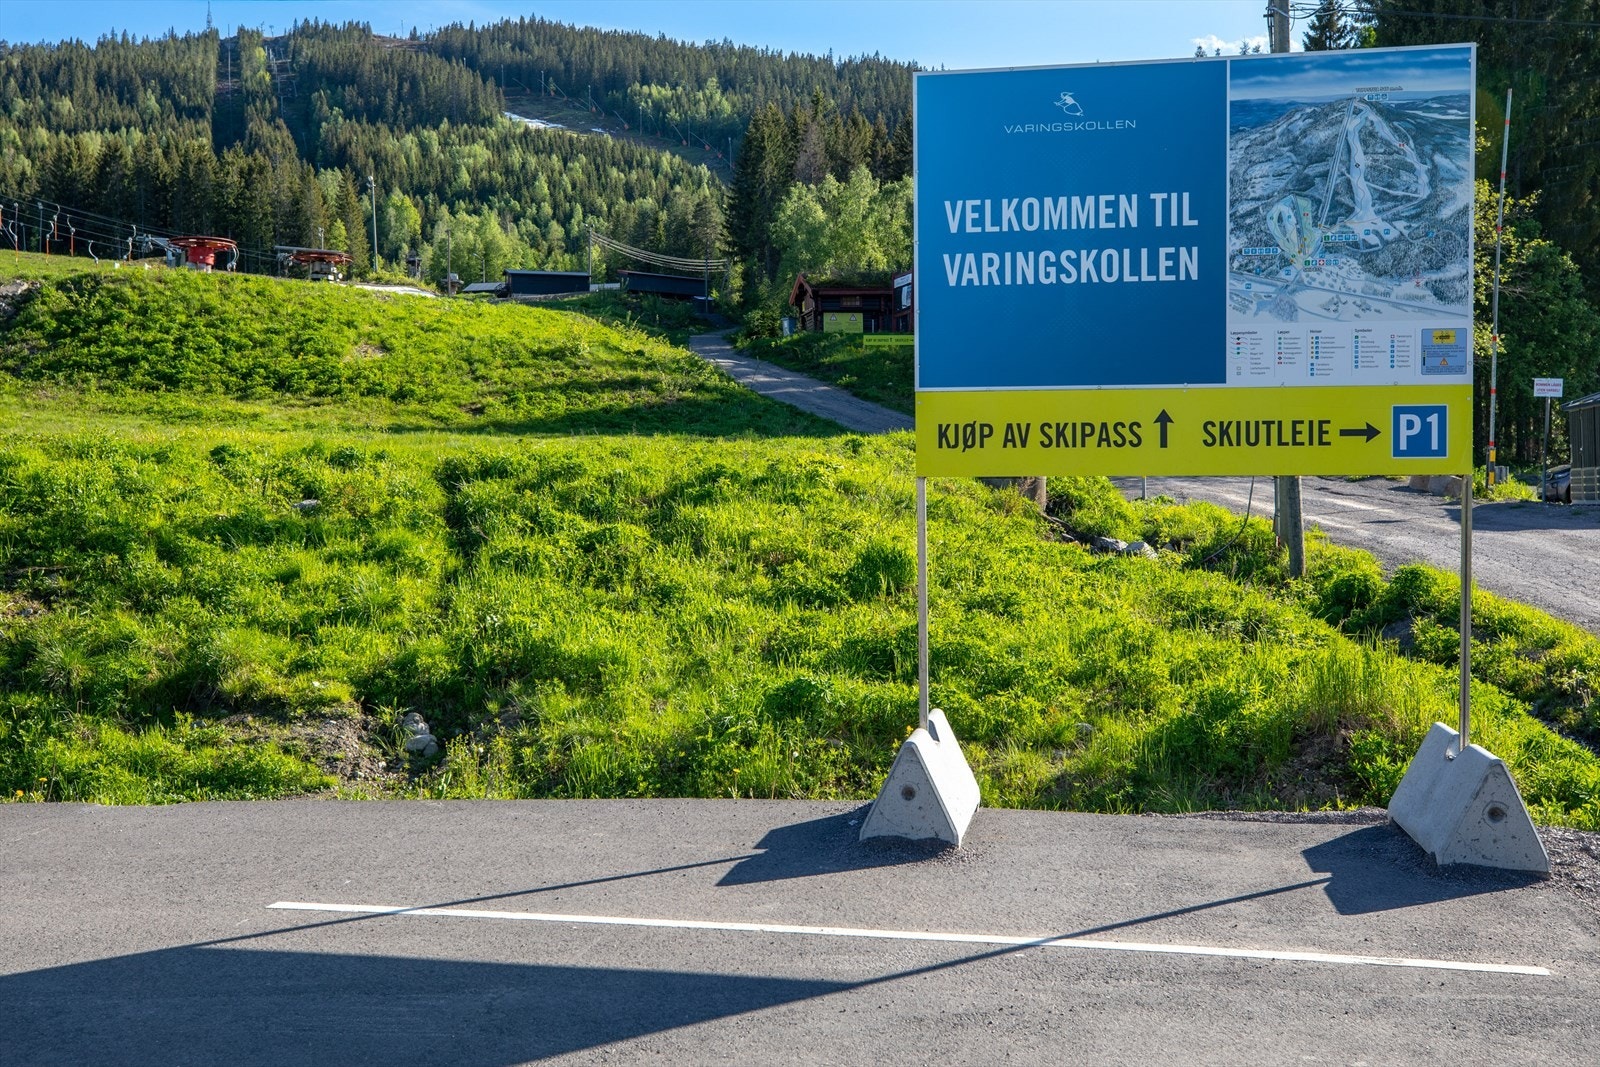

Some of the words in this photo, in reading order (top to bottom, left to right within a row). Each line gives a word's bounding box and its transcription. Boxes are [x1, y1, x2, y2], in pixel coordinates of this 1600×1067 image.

[1004, 120, 1136, 134] VARINGSKOLLEN
[944, 195, 1138, 234] VELKOMMEN
[1150, 192, 1199, 227] TIL
[943, 246, 1198, 287] VARINGSKOLLEN
[937, 420, 994, 453] KJØP
[1002, 422, 1032, 449] AV
[1039, 421, 1143, 449] SKIPASS
[1201, 419, 1332, 448] SKIUTLEIE
[1399, 413, 1439, 450] P1
